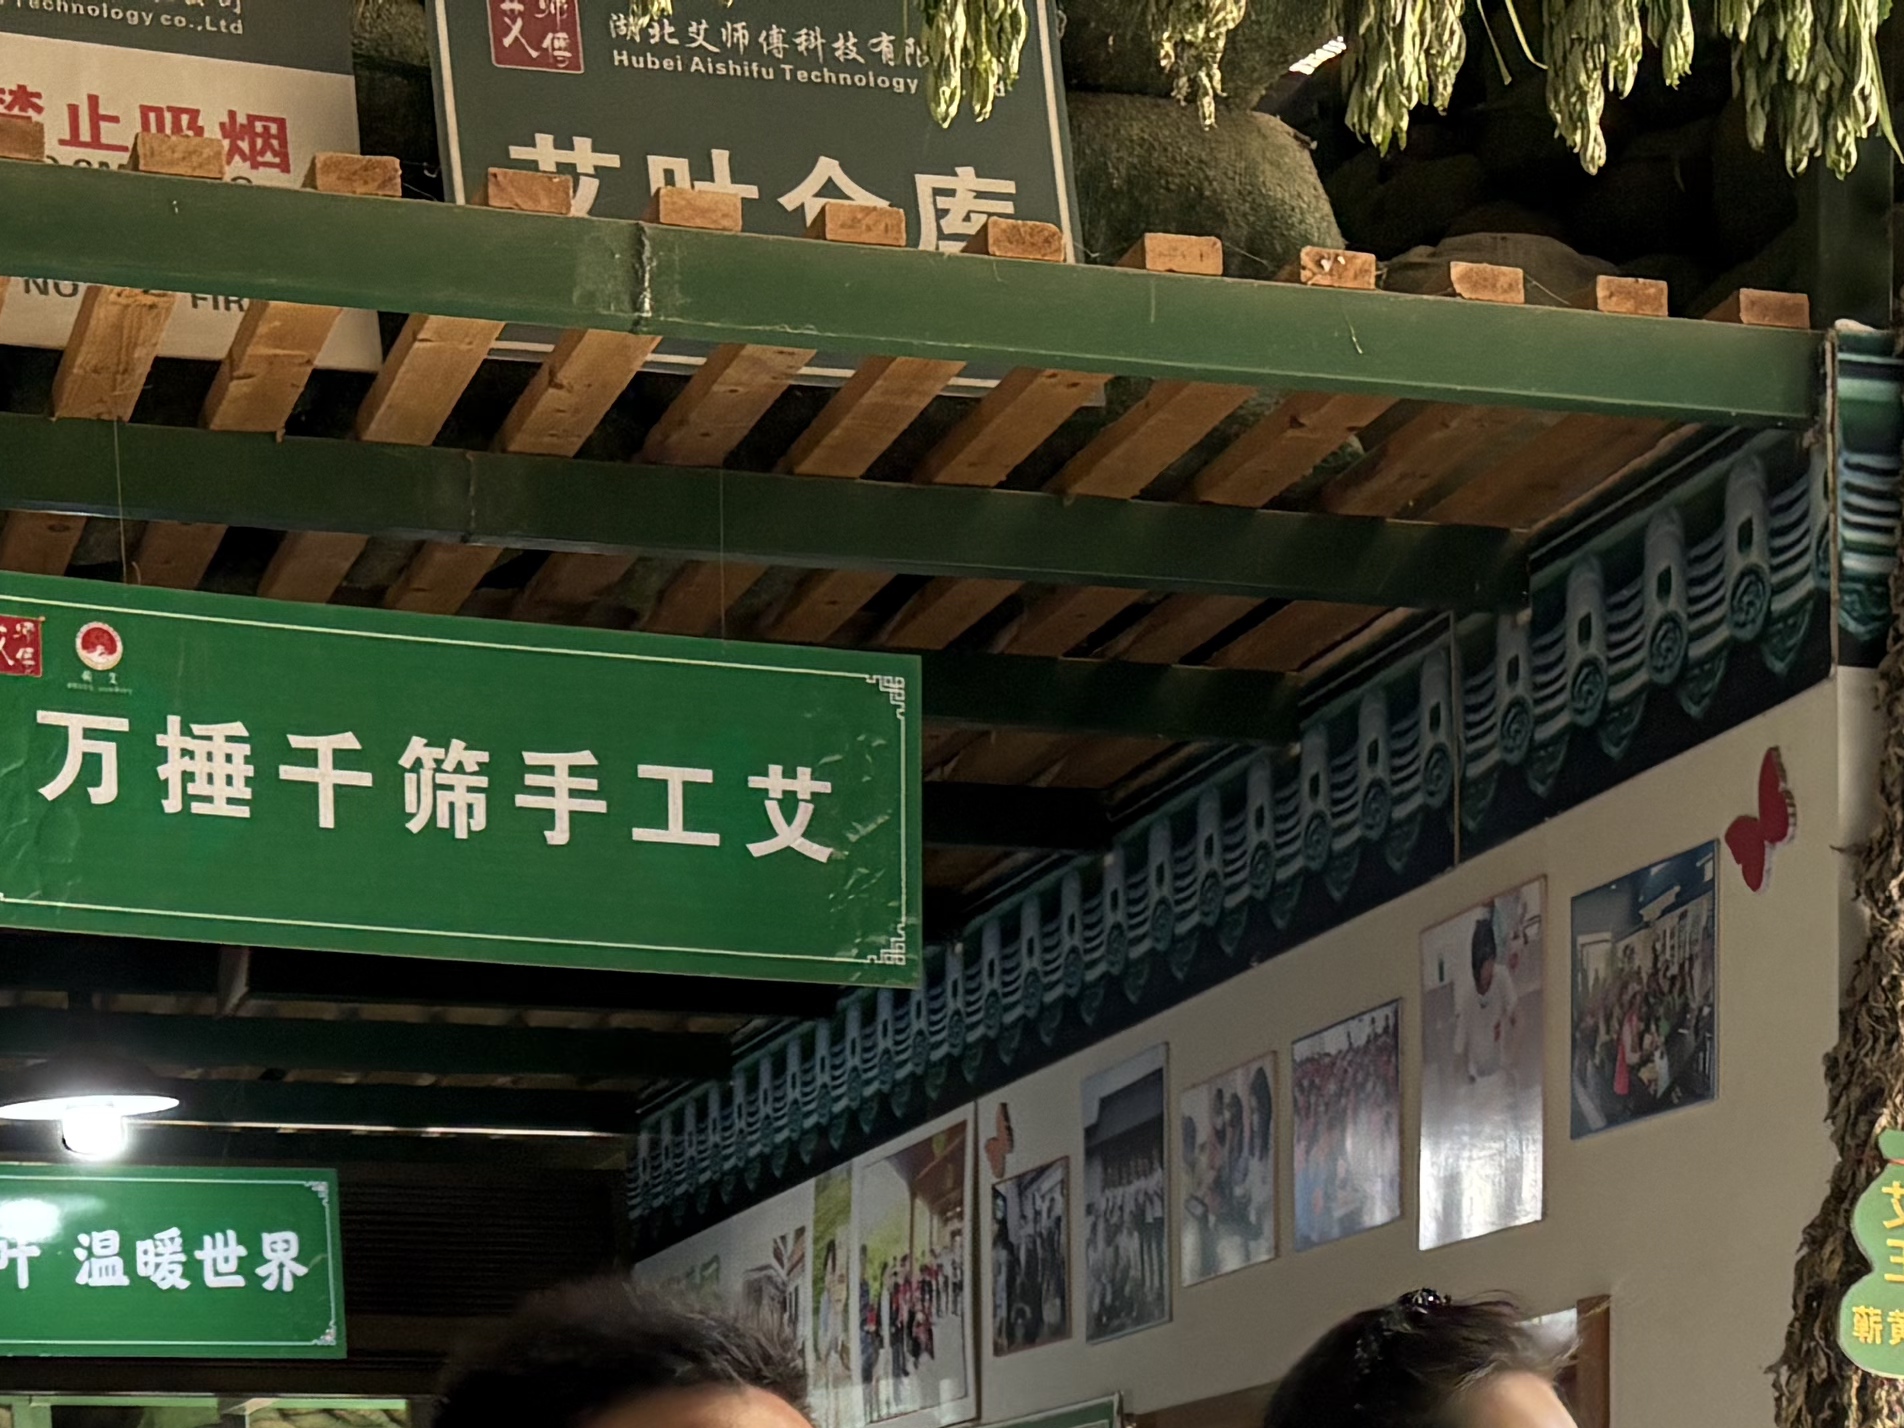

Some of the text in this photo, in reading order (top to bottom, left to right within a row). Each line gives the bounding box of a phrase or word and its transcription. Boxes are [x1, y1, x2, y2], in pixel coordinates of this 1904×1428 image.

[613, 50, 918, 95] Hubei Aishifu Technology
[35, 708, 833, 865] 万捶千筛手工艾
[74, 1229, 310, 1294] 温暖世界
